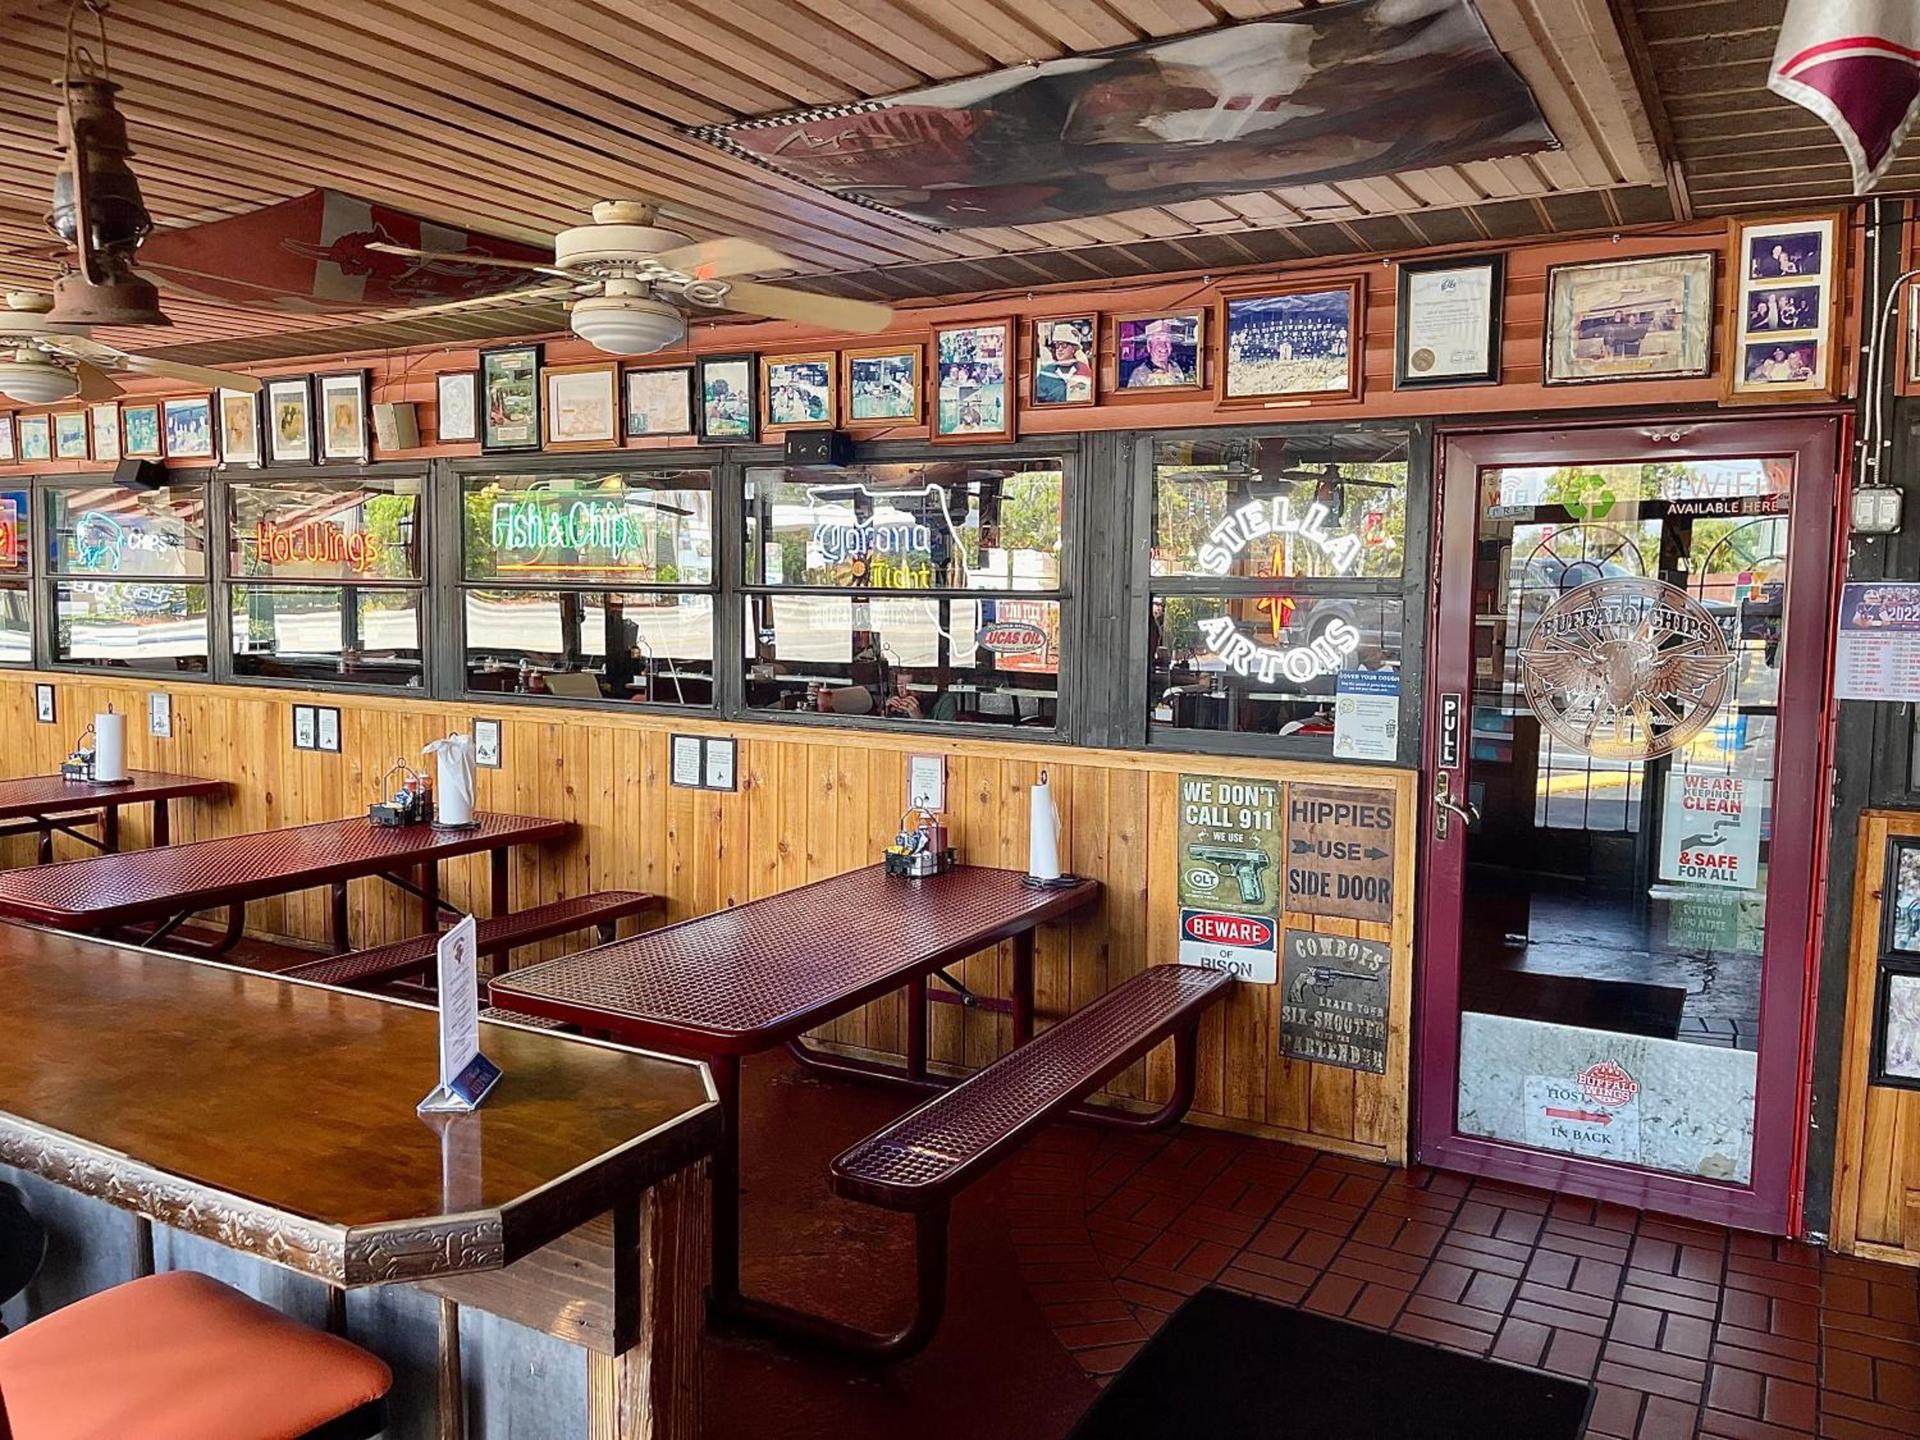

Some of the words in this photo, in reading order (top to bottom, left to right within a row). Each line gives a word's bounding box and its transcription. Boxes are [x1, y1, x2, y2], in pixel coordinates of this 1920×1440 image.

[1667, 500, 1740, 515] AVAILABLE
[1742, 499, 1779, 513] HERE
[549, 509, 566, 548] &
[1199, 496, 1363, 576] STELLA
[256, 521, 299, 561] Hot
[304, 521, 380, 573] Wings
[814, 523, 932, 564] Corona
[1541, 606, 1638, 640] BUFFALO
[1649, 607, 1711, 642] CHIPS
[985, 632, 1019, 644] LUCAS
[1022, 632, 1041, 645] OIL
[1197, 616, 1361, 684] ARTOIS
[1443, 700, 1457, 761] PULL
[1684, 775, 1709, 789] WE
[1712, 778, 1744, 792] ARE
[1684, 787, 1730, 800] KEEPING
[1732, 791, 1744, 800] IT
[1184, 782, 1213, 803] WE
[1218, 784, 1276, 807] DON'T
[1683, 796, 1742, 814] CLEAN
[1185, 804, 1234, 828] CALL
[1239, 808, 1272, 831] 911
[1291, 800, 1393, 830] HIPPIES
[1213, 831, 1227, 842] WE
[1228, 831, 1244, 843] USE
[1317, 840, 1362, 861] USE
[1678, 851, 1692, 865] &
[1694, 852, 1739, 870] SAFE
[1677, 865, 1707, 879] FOR
[1709, 867, 1738, 882] ALL
[1289, 868, 1332, 898] SIDE
[1336, 873, 1392, 904] DOOR
[1193, 918, 1262, 942] BEWARE
[1219, 949, 1233, 958] OF
[1295, 937, 1384, 971] COWBOYS
[1200, 957, 1253, 977] BISON
[1319, 997, 1353, 1012] LEAVE
[1357, 1003, 1386, 1018] YOUR
[1282, 1005, 1386, 1039] SIX-SHOOTER
[1577, 1073, 1638, 1093] BUFFALO
[1586, 1085, 1631, 1101] WINGS
[1551, 1127, 1568, 1138] IN
[1573, 1130, 1612, 1144] BACK
